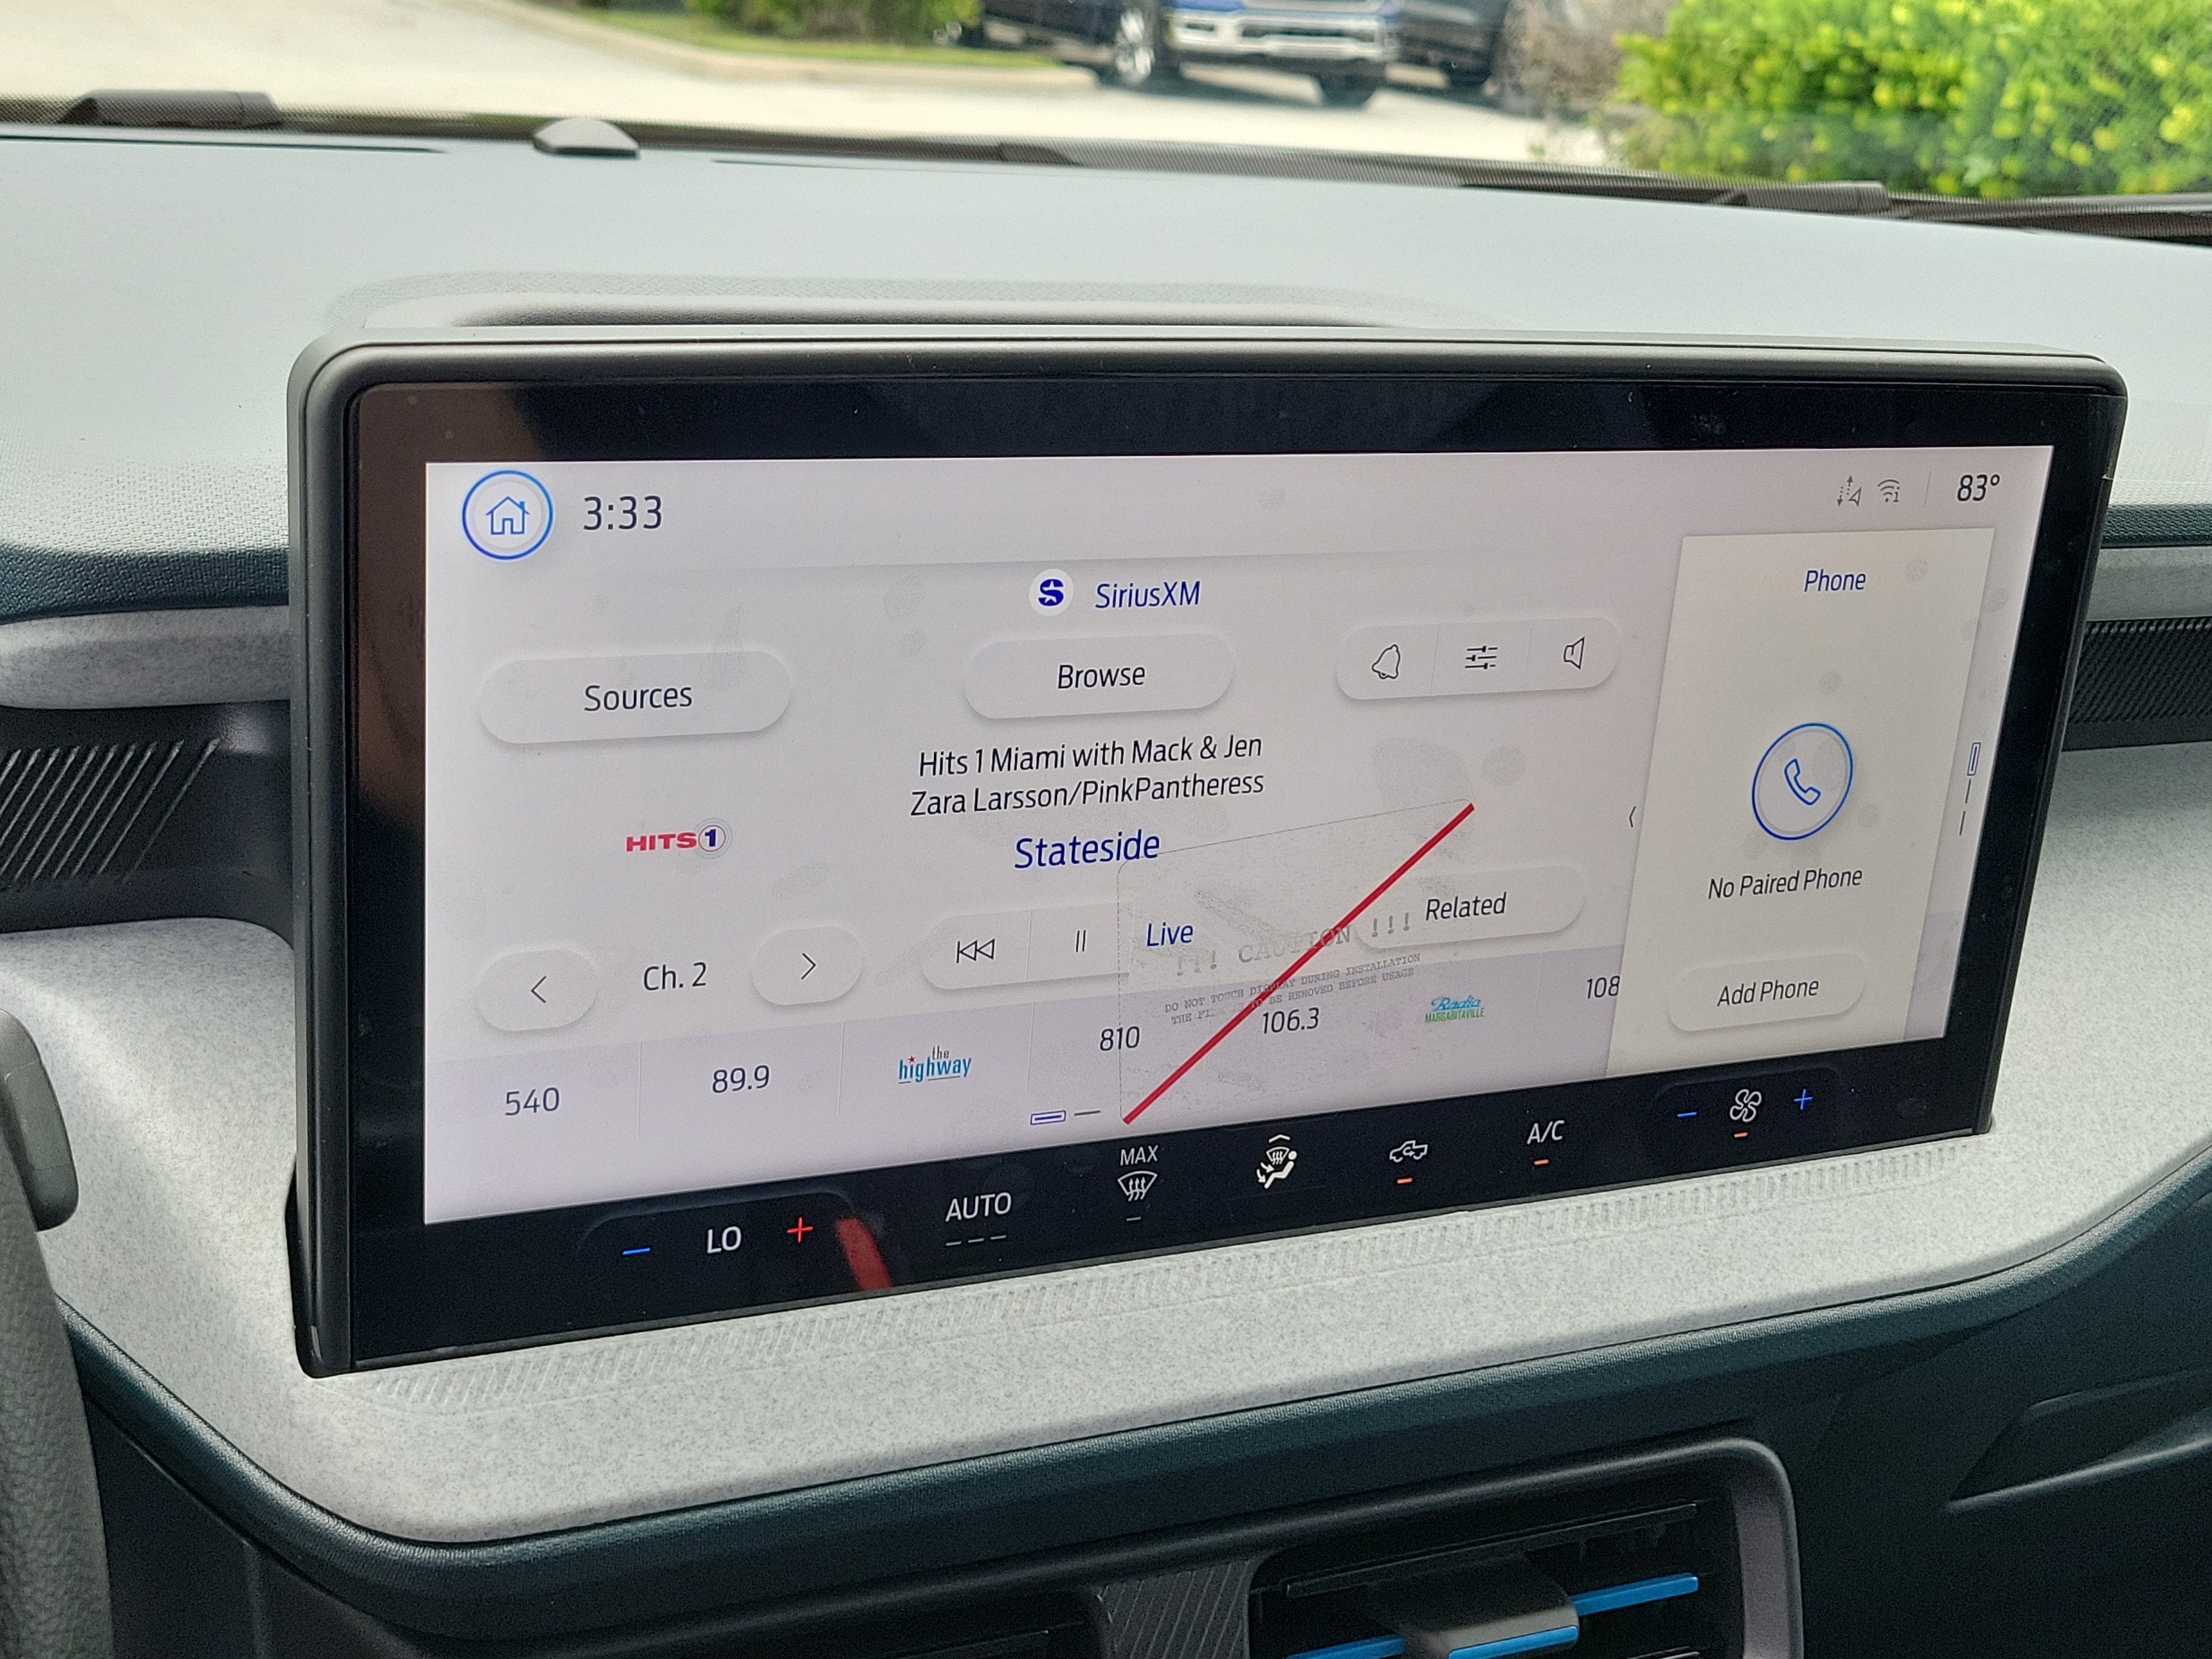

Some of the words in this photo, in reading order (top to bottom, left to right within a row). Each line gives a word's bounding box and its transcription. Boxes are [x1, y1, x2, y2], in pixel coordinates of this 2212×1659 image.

[583, 495, 663, 531] 3:33
[1804, 568, 1866, 592] Phone
[1096, 581, 1201, 608] SiriusXM
[1058, 664, 1146, 689] Browse
[584, 684, 693, 712] Sources
[919, 751, 968, 776] Hits
[975, 749, 984, 774] 1
[991, 743, 1065, 772] Miami
[1073, 741, 1125, 768] with
[1132, 737, 1192, 764] Mack
[1200, 735, 1217, 759] &
[1224, 735, 1262, 759] Jen
[911, 789, 966, 816] Zara
[973, 773, 1264, 812] Larsson/PinkPantheress
[1015, 829, 1160, 868] Stateside
[1708, 877, 1734, 899] No
[1740, 871, 1800, 896] Paired
[1803, 868, 1863, 890] Phone
[1425, 891, 1507, 921] Related
[1146, 922, 1193, 947] Live
[1238, 924, 1351, 963] CAUTION
[644, 964, 684, 990] Ch.
[692, 962, 707, 987] 2
[1165, 1003, 1178, 1013] DO
[1184, 997, 1205, 1010] NOT
[1211, 989, 1244, 1004] TOUCH
[1301, 970, 1340, 985] DURING
[1345, 953, 1421, 977] INSTALLATION
[1587, 975, 1621, 999] 108
[1171, 1013, 1192, 1025] THE
[1269, 996, 1283, 1005] BE
[1289, 984, 1334, 1001] REMOVED
[1339, 975, 1377, 990] BEFORE
[1382, 968, 1414, 981] USAGE
[1717, 983, 1754, 1007] Add
[1759, 980, 1819, 1002] Phone
[1263, 1008, 1319, 1034] 106.3
[932, 1045, 950, 1060] the
[1099, 1026, 1140, 1051] 810
[712, 1065, 770, 1093] 89.9
[899, 1056, 972, 1082] highway
[505, 1087, 561, 1116] 540
[1527, 1120, 1565, 1144] A/C
[1120, 1146, 1159, 1166] MAX
[945, 1192, 1012, 1222] AUTO
[707, 1226, 742, 1254] LO
